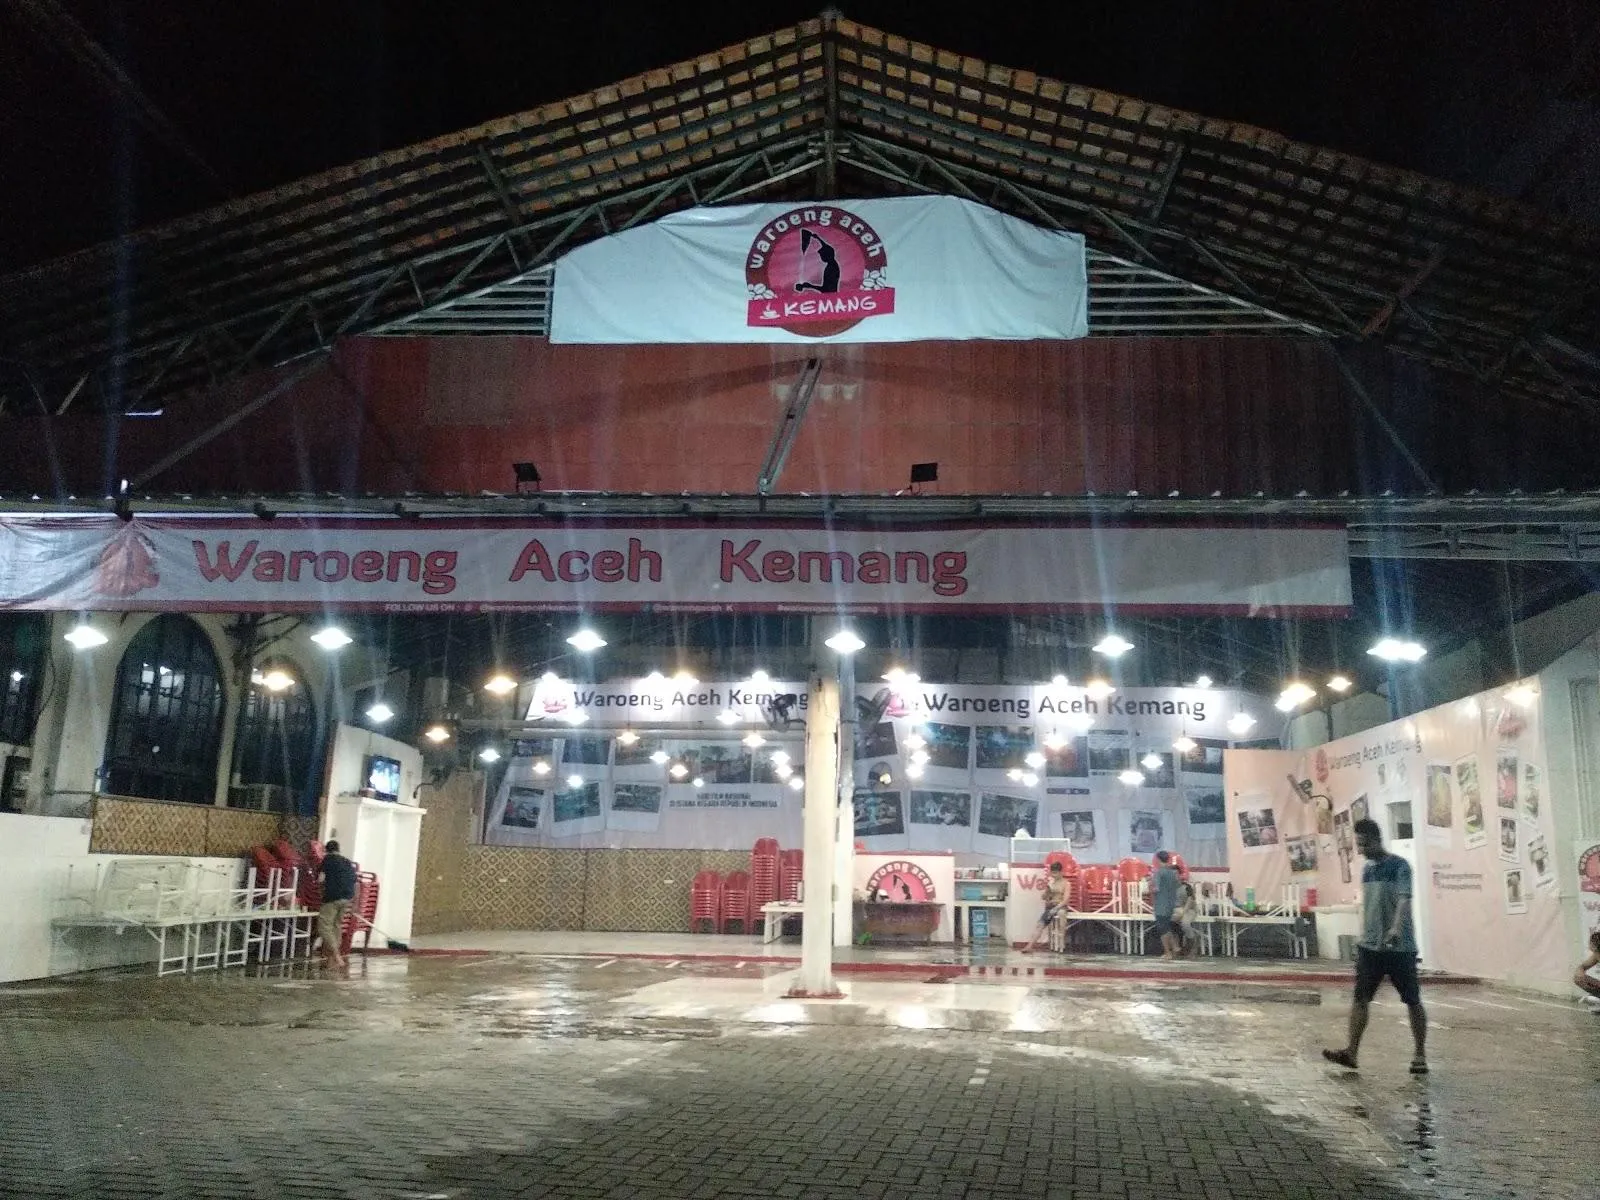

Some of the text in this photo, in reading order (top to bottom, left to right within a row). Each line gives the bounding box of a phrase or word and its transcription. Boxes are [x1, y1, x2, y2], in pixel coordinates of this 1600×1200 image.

[750, 209, 884, 269] waroeng aceh
[784, 296, 877, 317] KEMANG
[192, 537, 968, 596] Waroeng Aceh Kemang
[574, 691, 663, 711] Waroeng
[672, 689, 720, 707] Aceh
[923, 692, 1205, 721] Waroeng Aceh Kemang
